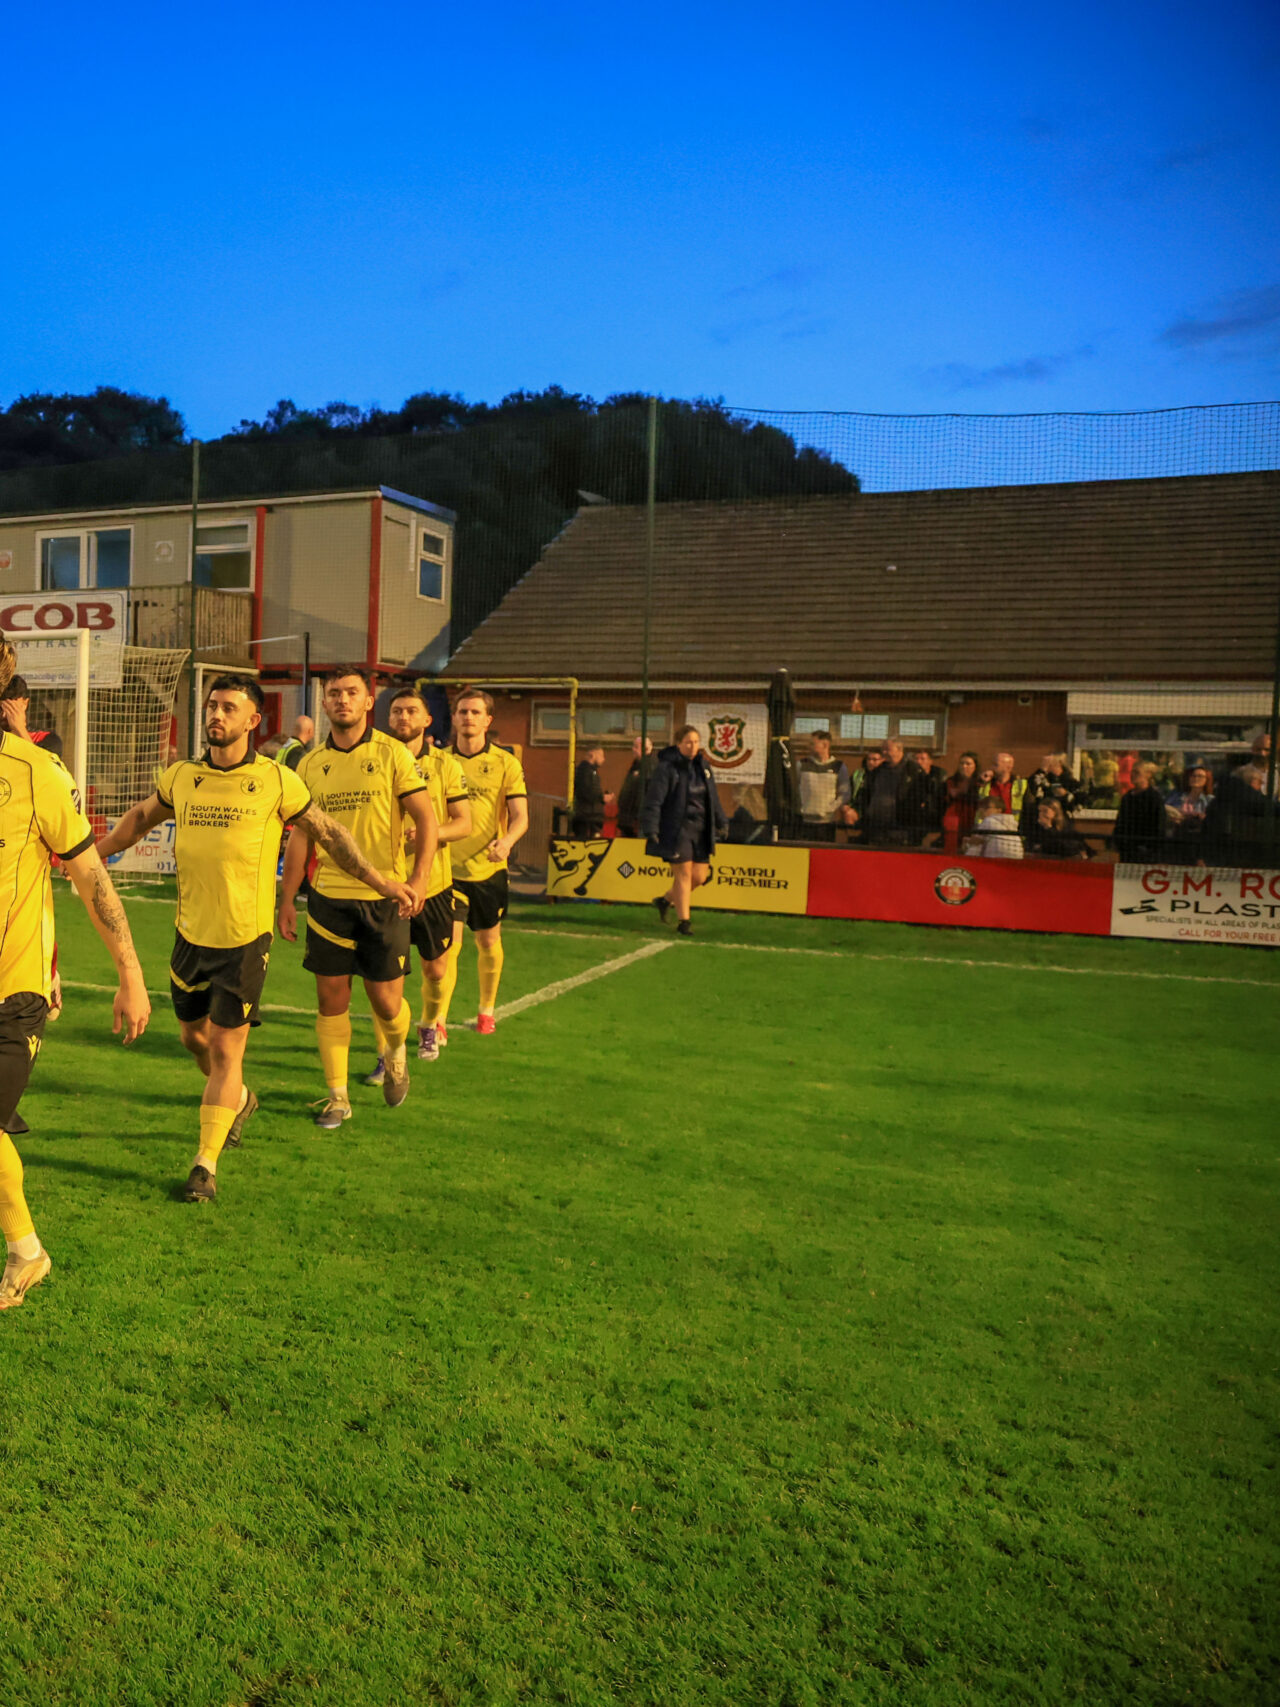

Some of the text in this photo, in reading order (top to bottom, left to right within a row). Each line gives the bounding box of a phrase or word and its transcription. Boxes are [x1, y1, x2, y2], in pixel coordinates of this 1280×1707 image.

[326, 791, 352, 800] SOUTH
[327, 797, 371, 806] INSURANCE
[190, 804, 257, 816] SOUTH WALES
[328, 804, 362, 813] BROKERS
[189, 812, 241, 822] INSURANCE
[188, 820, 230, 828] BROKERS
[135, 845, 160, 857] MOT
[718, 865, 776, 878] CYMRU
[718, 876, 788, 890] PREMIER
[1141, 869, 1222, 898] G.M.
[1146, 915, 1193, 925] SPECIALISTS
[1194, 917, 1202, 925] IN
[1204, 918, 1218, 926] ALL
[1221, 919, 1246, 928] AREAS
[1248, 920, 1260, 928] OF
[1178, 928, 1276, 942] CALL FOR YOUR FREE
